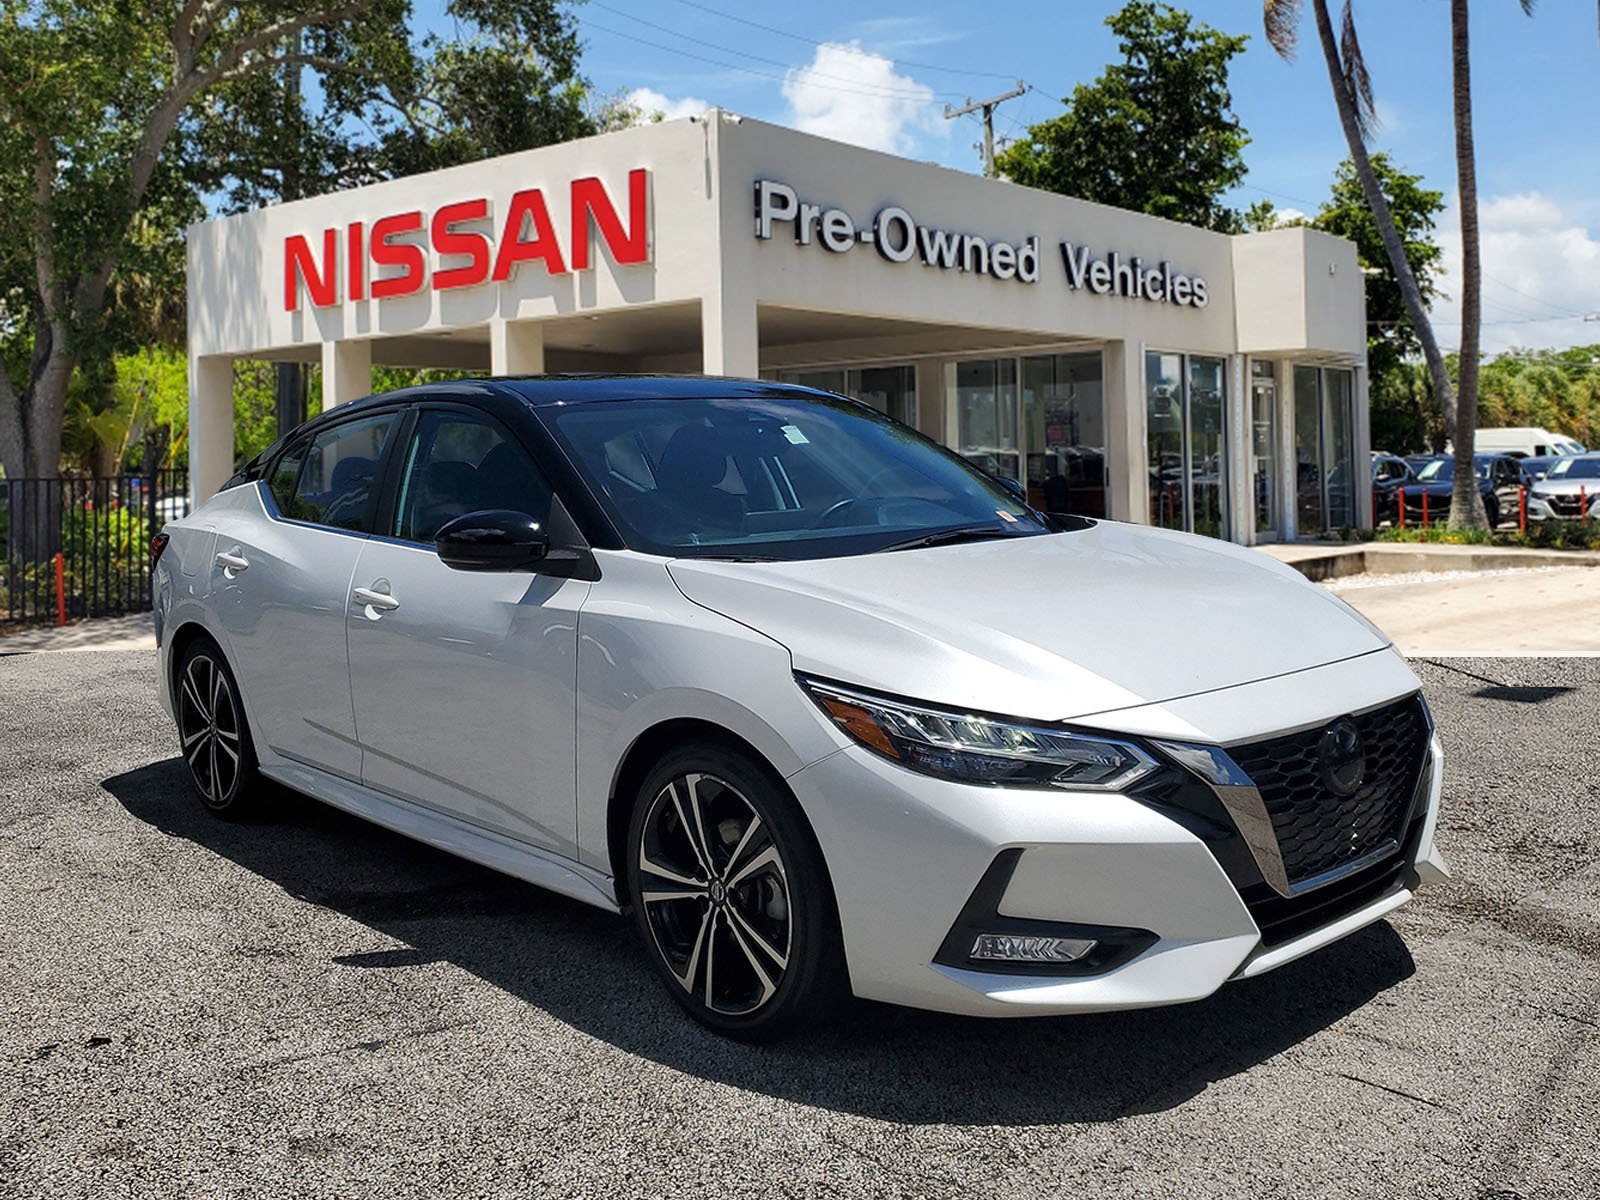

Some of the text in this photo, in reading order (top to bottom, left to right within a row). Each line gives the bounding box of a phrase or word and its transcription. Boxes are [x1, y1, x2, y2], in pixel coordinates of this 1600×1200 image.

[284, 168, 648, 312] NISSAN
[755, 180, 1209, 308] Pre-Owned Vehicles
